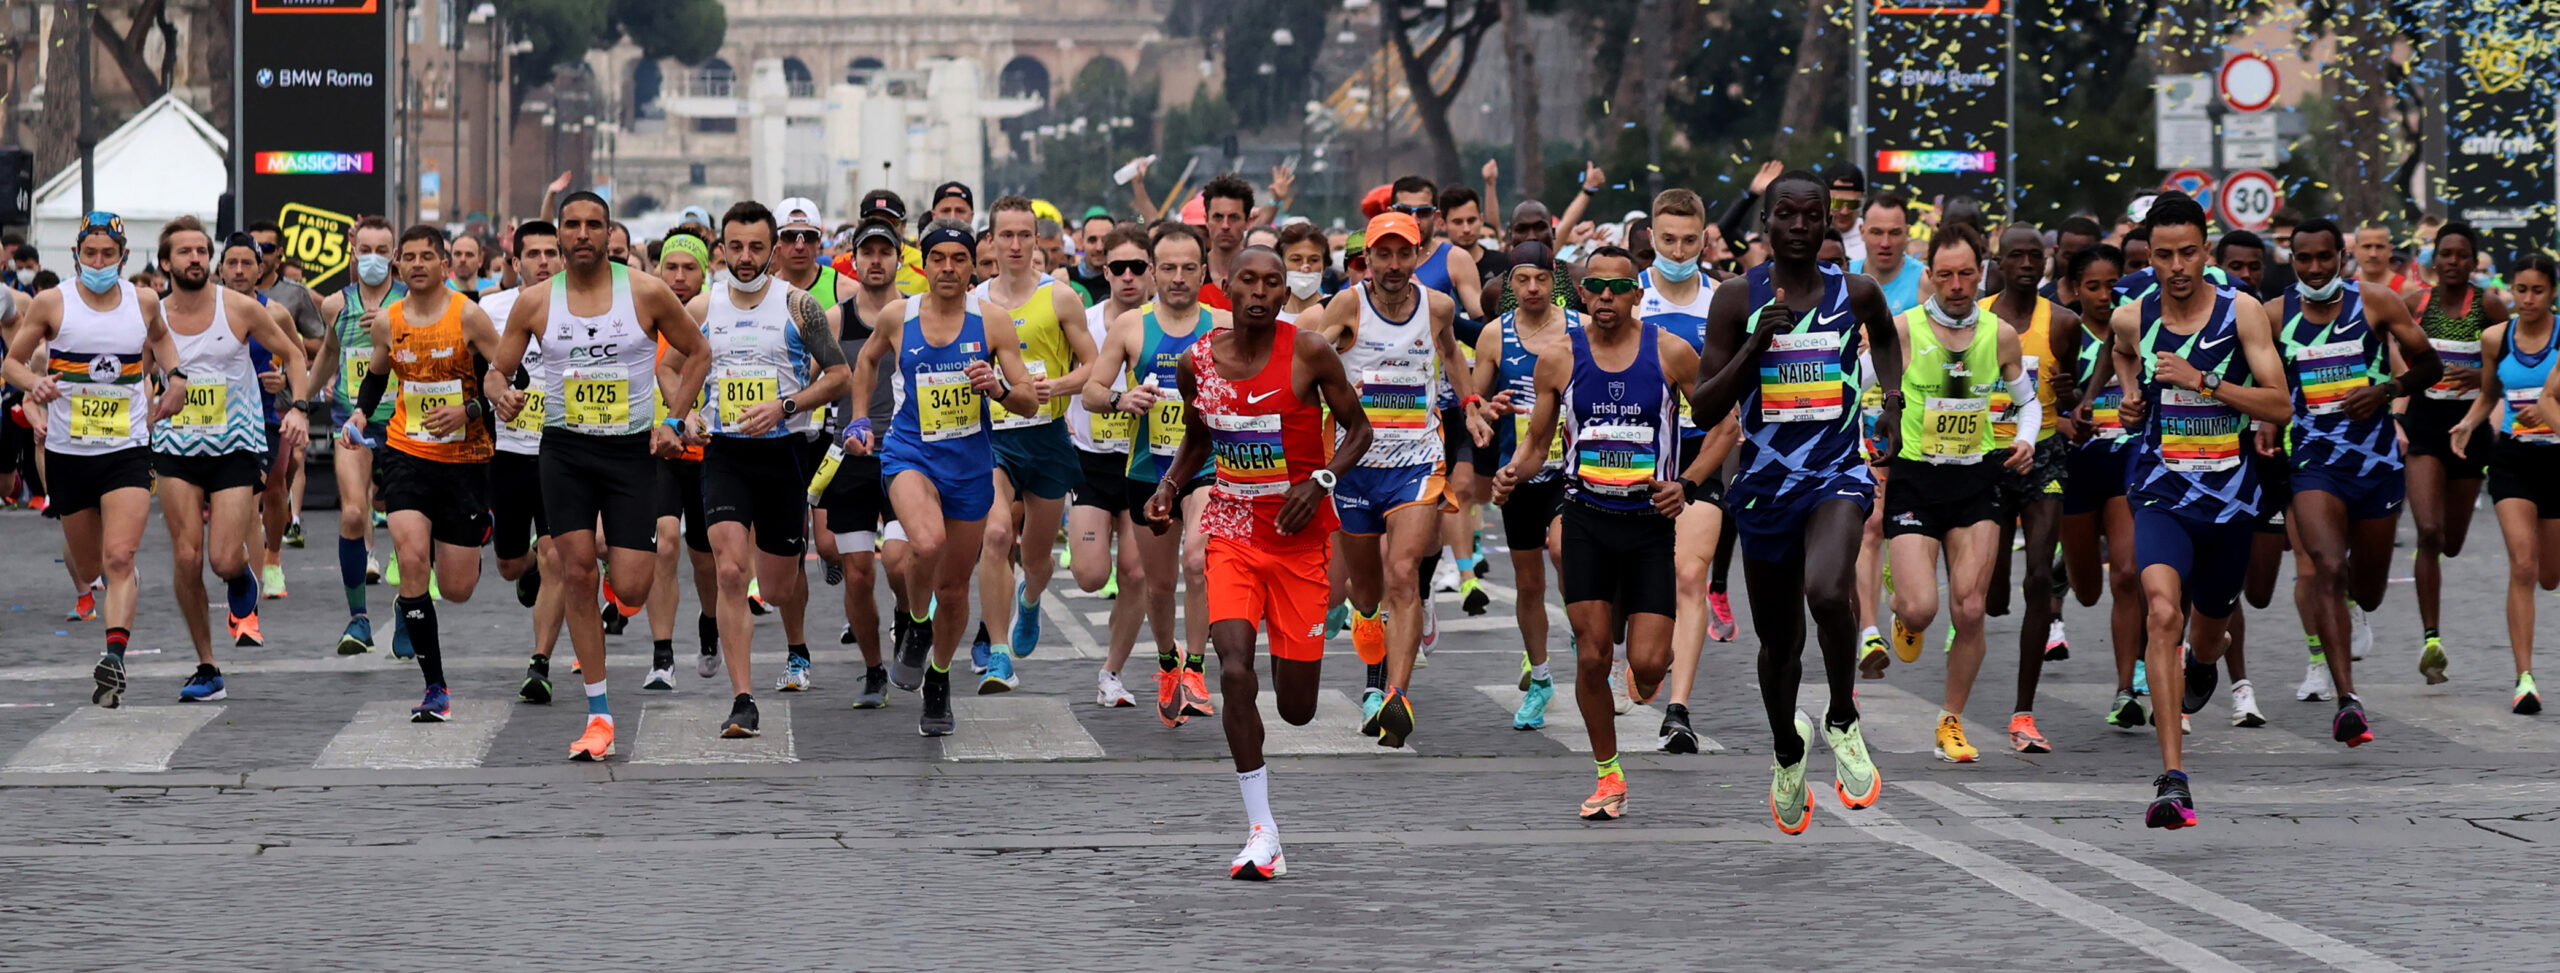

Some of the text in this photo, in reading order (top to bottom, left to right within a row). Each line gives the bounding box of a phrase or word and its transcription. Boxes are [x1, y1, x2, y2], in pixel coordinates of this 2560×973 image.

[280, 69, 373, 87] BMW Roma
[267, 154, 361, 172] MASSIGEN
[2235, 188, 2269, 214] 30
[298, 213, 339, 232] RADIO
[283, 224, 345, 267] 105
[1793, 337, 1828, 348] acea
[1778, 361, 1824, 384] NAIBEI
[2313, 365, 2354, 384] TEFERA
[576, 384, 616, 404] 6125
[727, 382, 764, 402] 8161
[931, 387, 971, 409] 3415
[1371, 393, 1416, 409] GIORGIO
[82, 399, 119, 418] 5299
[1592, 402, 1642, 416] irish pub
[183, 416, 190, 425] 12
[202, 415, 213, 424] TOP
[516, 419, 527, 429] 10
[578, 414, 584, 424] 9
[599, 413, 612, 424] TOP
[729, 412, 736, 422] 11
[955, 416, 968, 427] TOP
[102, 427, 114, 436] TOP
[936, 420, 942, 430] 5
[1234, 420, 1266, 429] acea
[1937, 415, 1978, 434] 8705
[2166, 417, 2182, 435] EL
[1101, 430, 1112, 439] 10
[1159, 435, 1171, 444] 10
[1611, 431, 1641, 439] acea
[1217, 441, 1276, 470] PACER
[1935, 444, 1944, 454] 12
[1958, 444, 1970, 454] TOP
[1599, 450, 1635, 469] HAJJY
